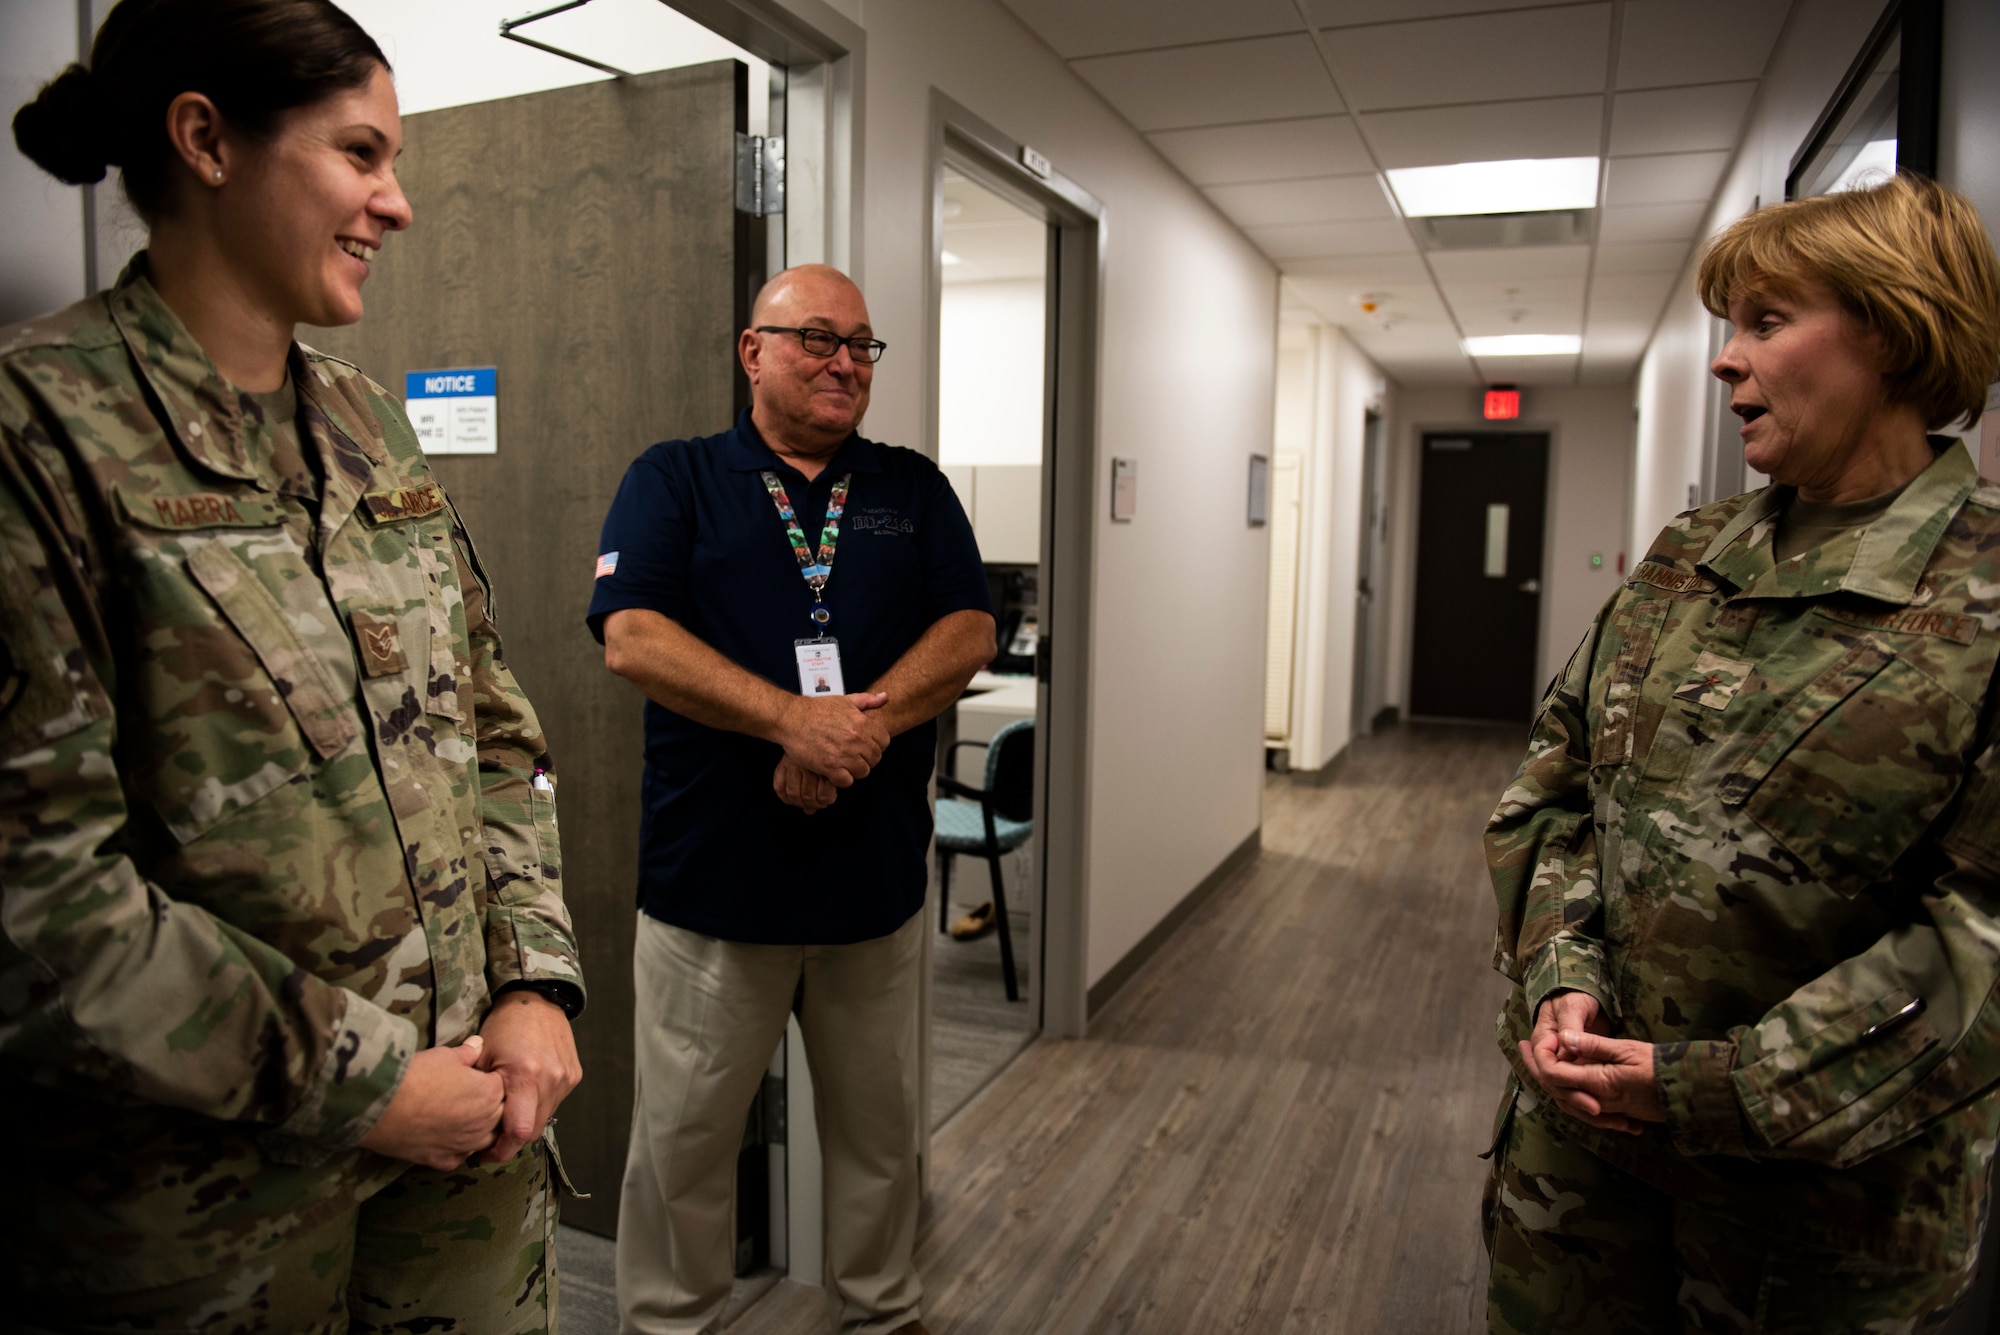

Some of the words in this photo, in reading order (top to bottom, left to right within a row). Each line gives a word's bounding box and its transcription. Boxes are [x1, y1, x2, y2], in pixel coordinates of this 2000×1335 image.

[425, 375, 476, 394] NOTICE
[1487, 392, 1518, 418] EXIT
[416, 427, 432, 438] ONE
[153, 496, 245, 527] MARRA
[1898, 609, 1970, 640] FORCE
